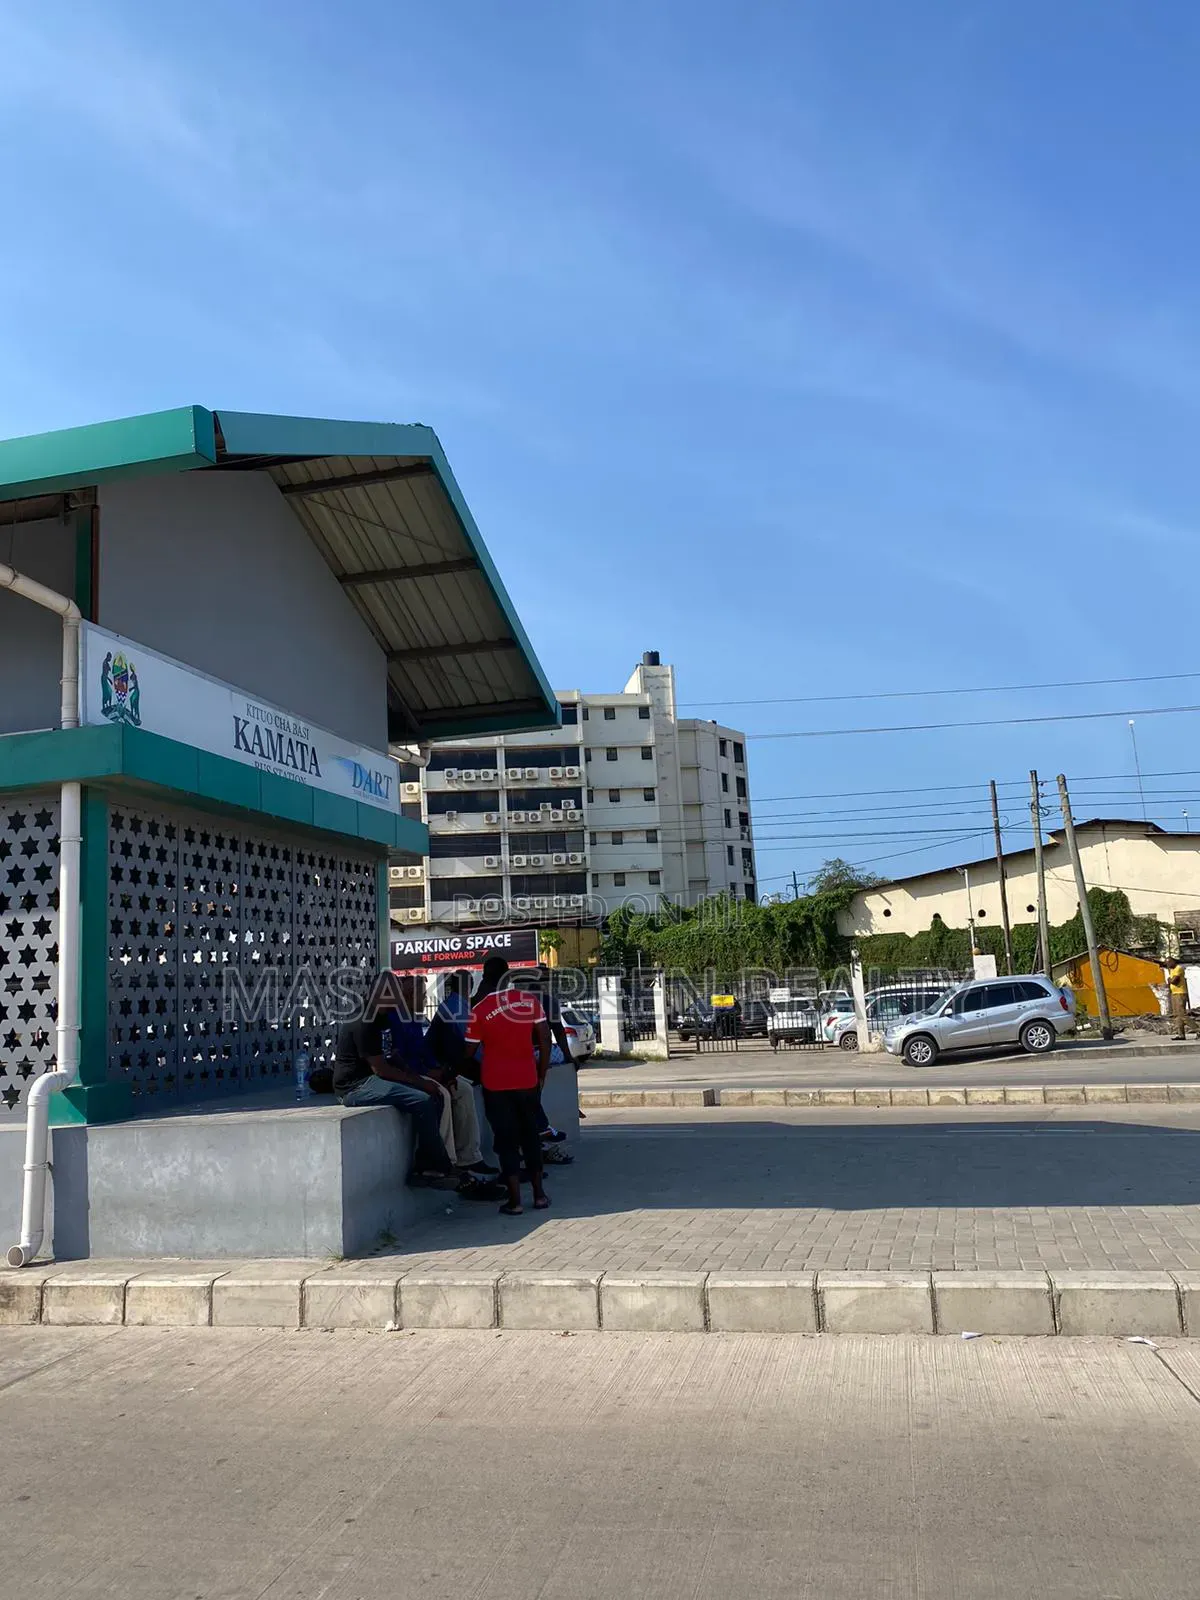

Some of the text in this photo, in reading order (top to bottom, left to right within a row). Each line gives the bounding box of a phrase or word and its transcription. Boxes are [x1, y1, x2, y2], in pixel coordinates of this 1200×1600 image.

[246, 703, 309, 740] KITUO CHA BASI
[233, 715, 321, 778] KAMATA
[352, 762, 392, 800] DART
[395, 934, 511, 955] PARKING SPACE
[421, 950, 475, 962] BE FORWARD
